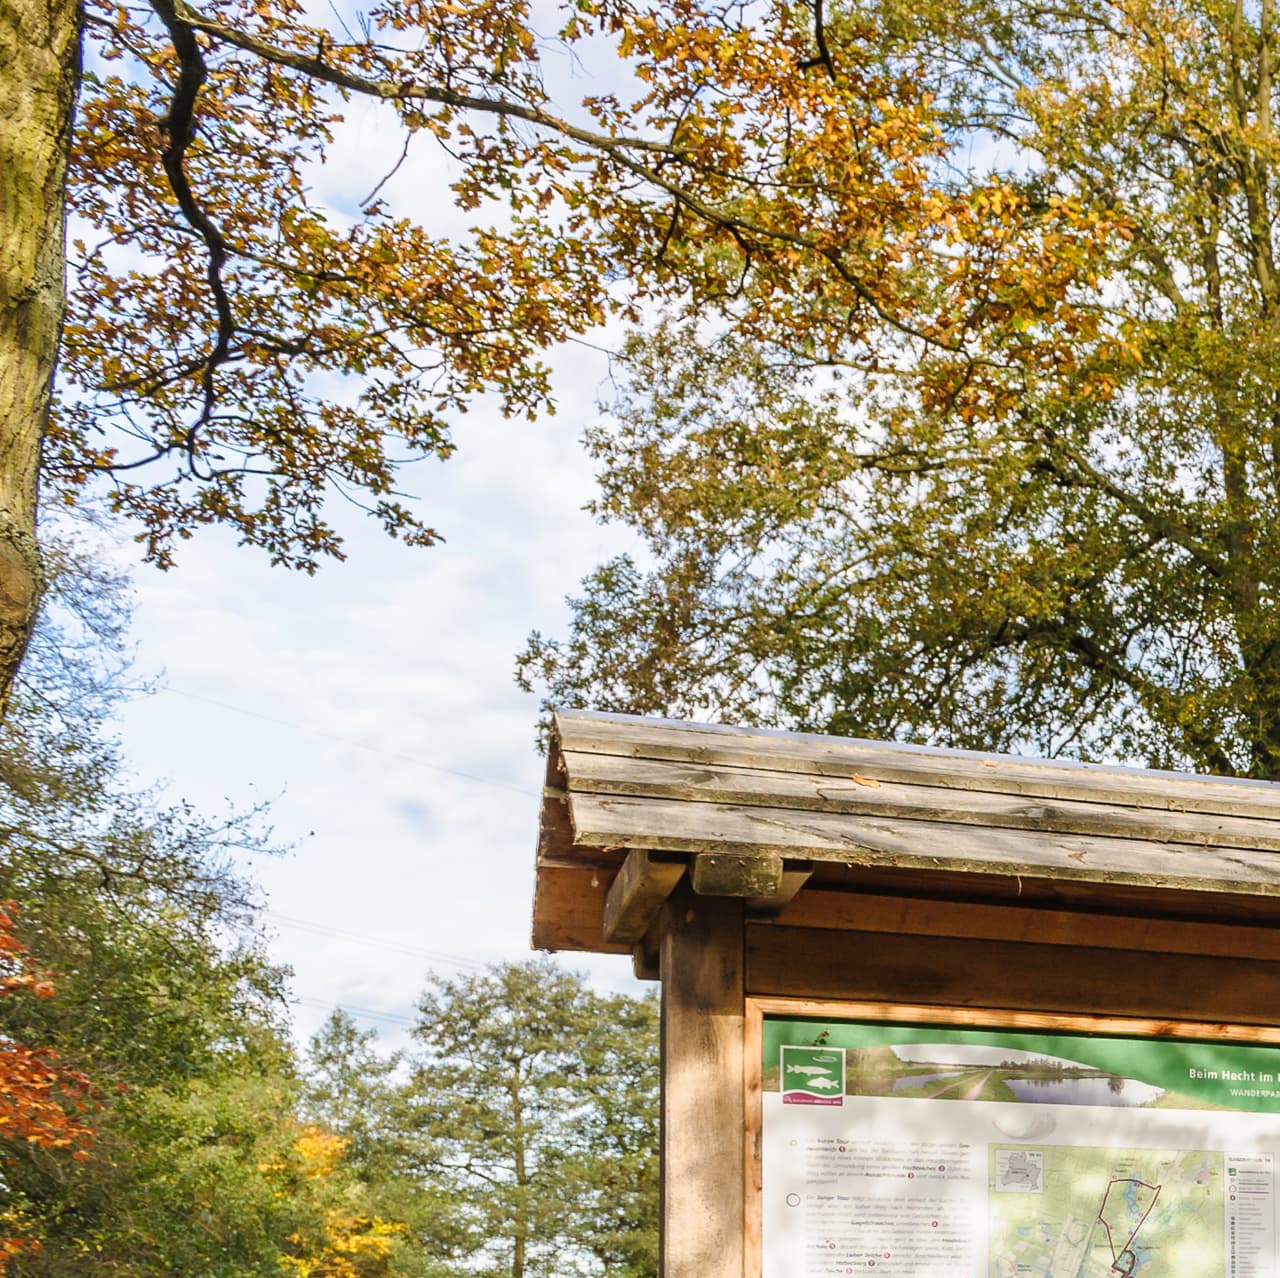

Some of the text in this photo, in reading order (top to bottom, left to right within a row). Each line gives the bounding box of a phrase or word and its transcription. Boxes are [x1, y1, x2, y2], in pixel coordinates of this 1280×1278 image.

[1189, 1068, 1217, 1080] Beim
[1222, 1070, 1255, 1081] Hecht
[1259, 1071, 1273, 1082] im
